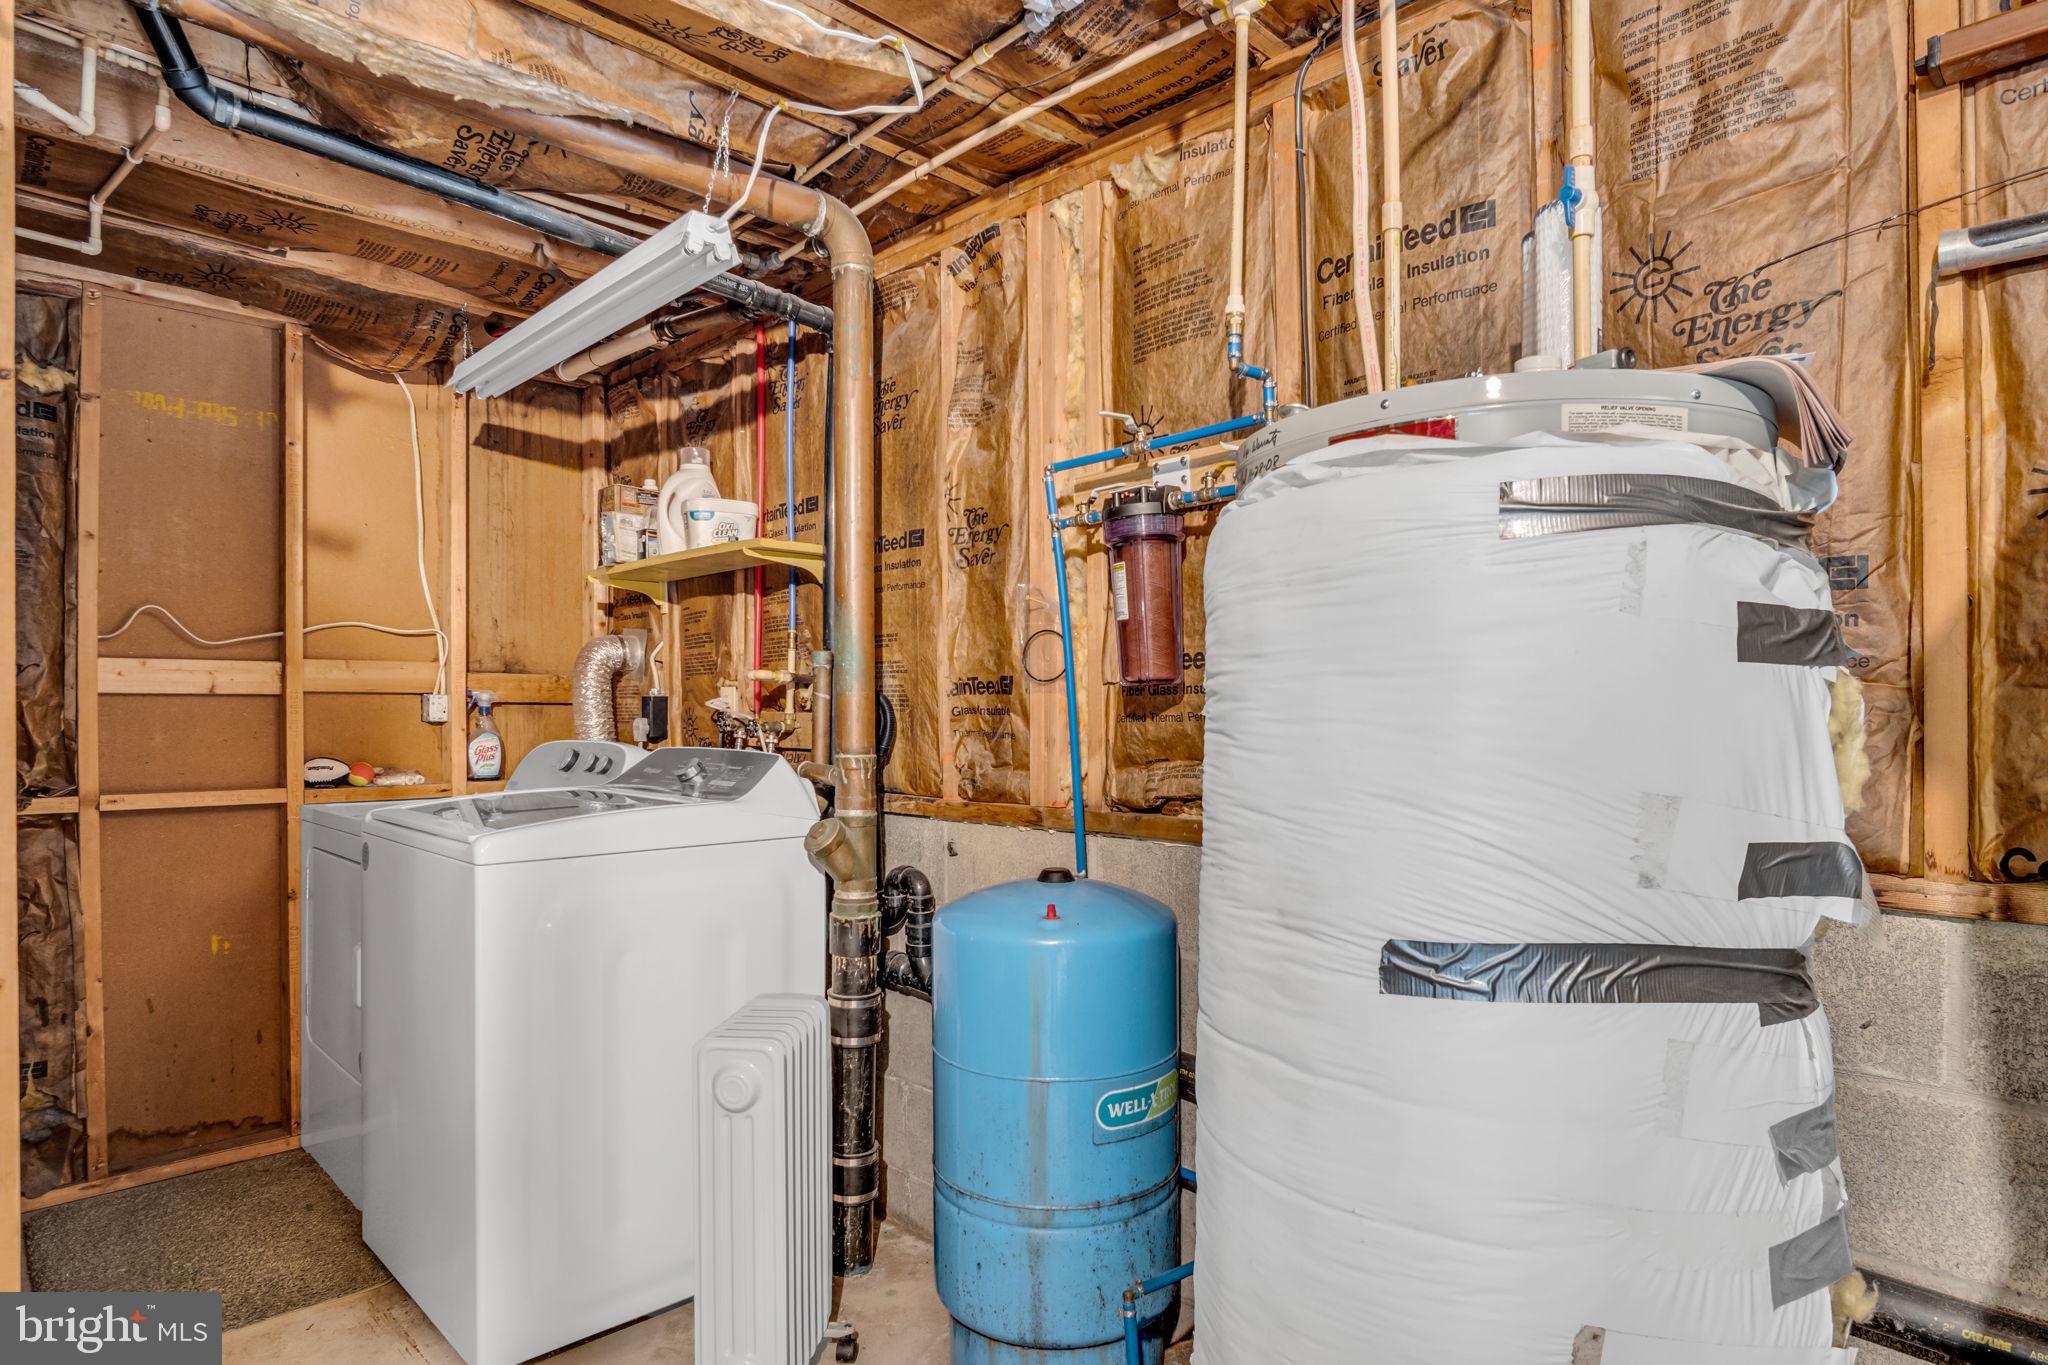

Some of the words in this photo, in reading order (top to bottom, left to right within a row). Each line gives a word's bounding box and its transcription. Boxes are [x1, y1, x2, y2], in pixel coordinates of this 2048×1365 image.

[1621, 31, 1637, 42] THIS
[1638, 21, 1660, 35] VAPOR
[1661, 7, 1690, 26] BARRIER
[1622, 34, 1649, 51] APPLIED
[1650, 24, 1678, 38] TOWARD
[1679, 15, 1695, 27] THE
[1695, 2, 1722, 20] HEATED
[1623, 45, 1645, 60] LIVING
[1646, 36, 1667, 49] SPACE
[1668, 32, 1678, 41] OF
[1680, 25, 1694, 36] THE
[1627, 77, 1641, 89] THIS
[1642, 68, 1663, 81] VAPOR
[1664, 57, 1694, 73] BARRIER
[1696, 46, 1721, 61] FACING
[1722, 42, 1730, 51] IS
[1629, 87, 1640, 98] AND
[1642, 75, 1667, 90] SHOULD
[1669, 70, 1683, 80] NOT
[1685, 65, 1695, 74] BE
[1751, 30, 1780, 46] SPECIAL
[1630, 94, 1645, 106] CARE
[1645, 83, 1671, 98] SHOULD
[1672, 78, 1682, 87] BE
[1685, 67, 1706, 83] TAKEN
[1707, 61, 1729, 72] WHEN
[1731, 45, 1764, 64] WORKING
[1678, 83, 1696, 95] WITH
[1708, 70, 1728, 81] OPEN
[1667, 115, 1678, 123] OR
[1712, 93, 1732, 107] WOOD
[1724, 80, 1743, 94] OVER
[1630, 144, 1646, 155] THIS
[1647, 136, 1670, 149] FACING
[1672, 126, 1698, 141] SHOULD
[1700, 121, 1710, 130] BE
[1749, 102, 1759, 110] TO
[1664, 121, 1687, 134] FLUES
[1689, 115, 1703, 126] AND
[1704, 102, 1730, 119] SIMILAR
[1732, 95, 1752, 108] HEAT
[1677, 140, 1687, 148] OF
[1722, 116, 1745, 129] LIGHT
[1785, 100, 1797, 110] DO
[1631, 161, 1645, 172] NOT
[1678, 148, 1688, 157] ON
[1690, 141, 1703, 151] TOP
[1704, 137, 1714, 146] OR
[1753, 120, 1763, 129] OF
[1765, 113, 1787, 125] SUCH
[1407, 247, 1490, 279] Insulation
[1412, 281, 1498, 311] Performance
[1703, 271, 1773, 316] The
[1672, 289, 1843, 348] Energy
